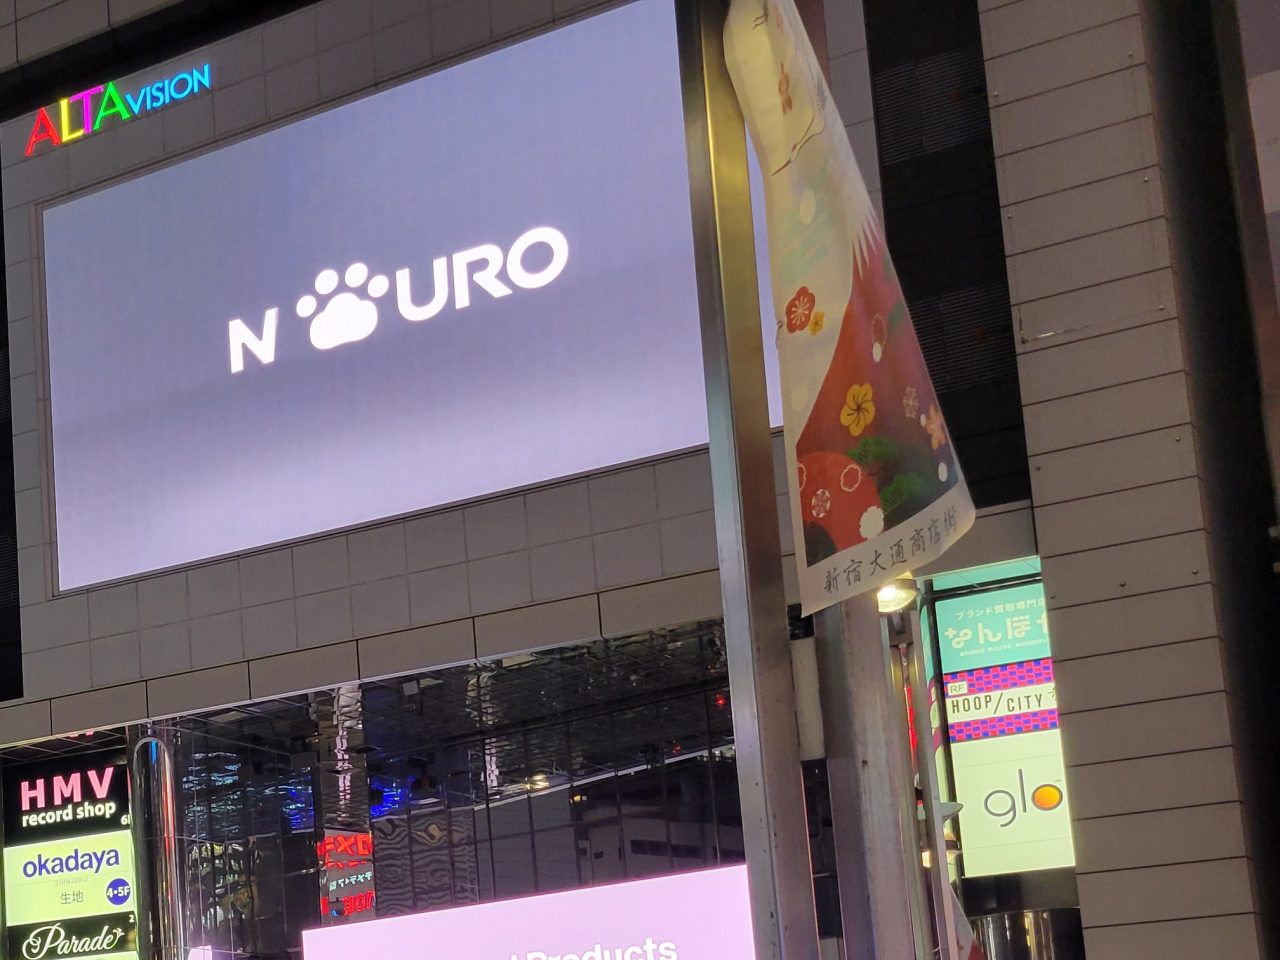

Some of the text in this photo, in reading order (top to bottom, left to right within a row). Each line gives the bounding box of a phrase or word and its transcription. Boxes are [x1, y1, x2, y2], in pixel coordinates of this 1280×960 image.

[824, 512, 958, 595] 新宿大通商店街
[950, 685, 965, 694] RF
[21, 766, 115, 811] HMV
[22, 800, 117, 828] record shop
[23, 848, 120, 879] okadaya
[60, 889, 85, 905] 生地
[22, 922, 125, 960] Parade
